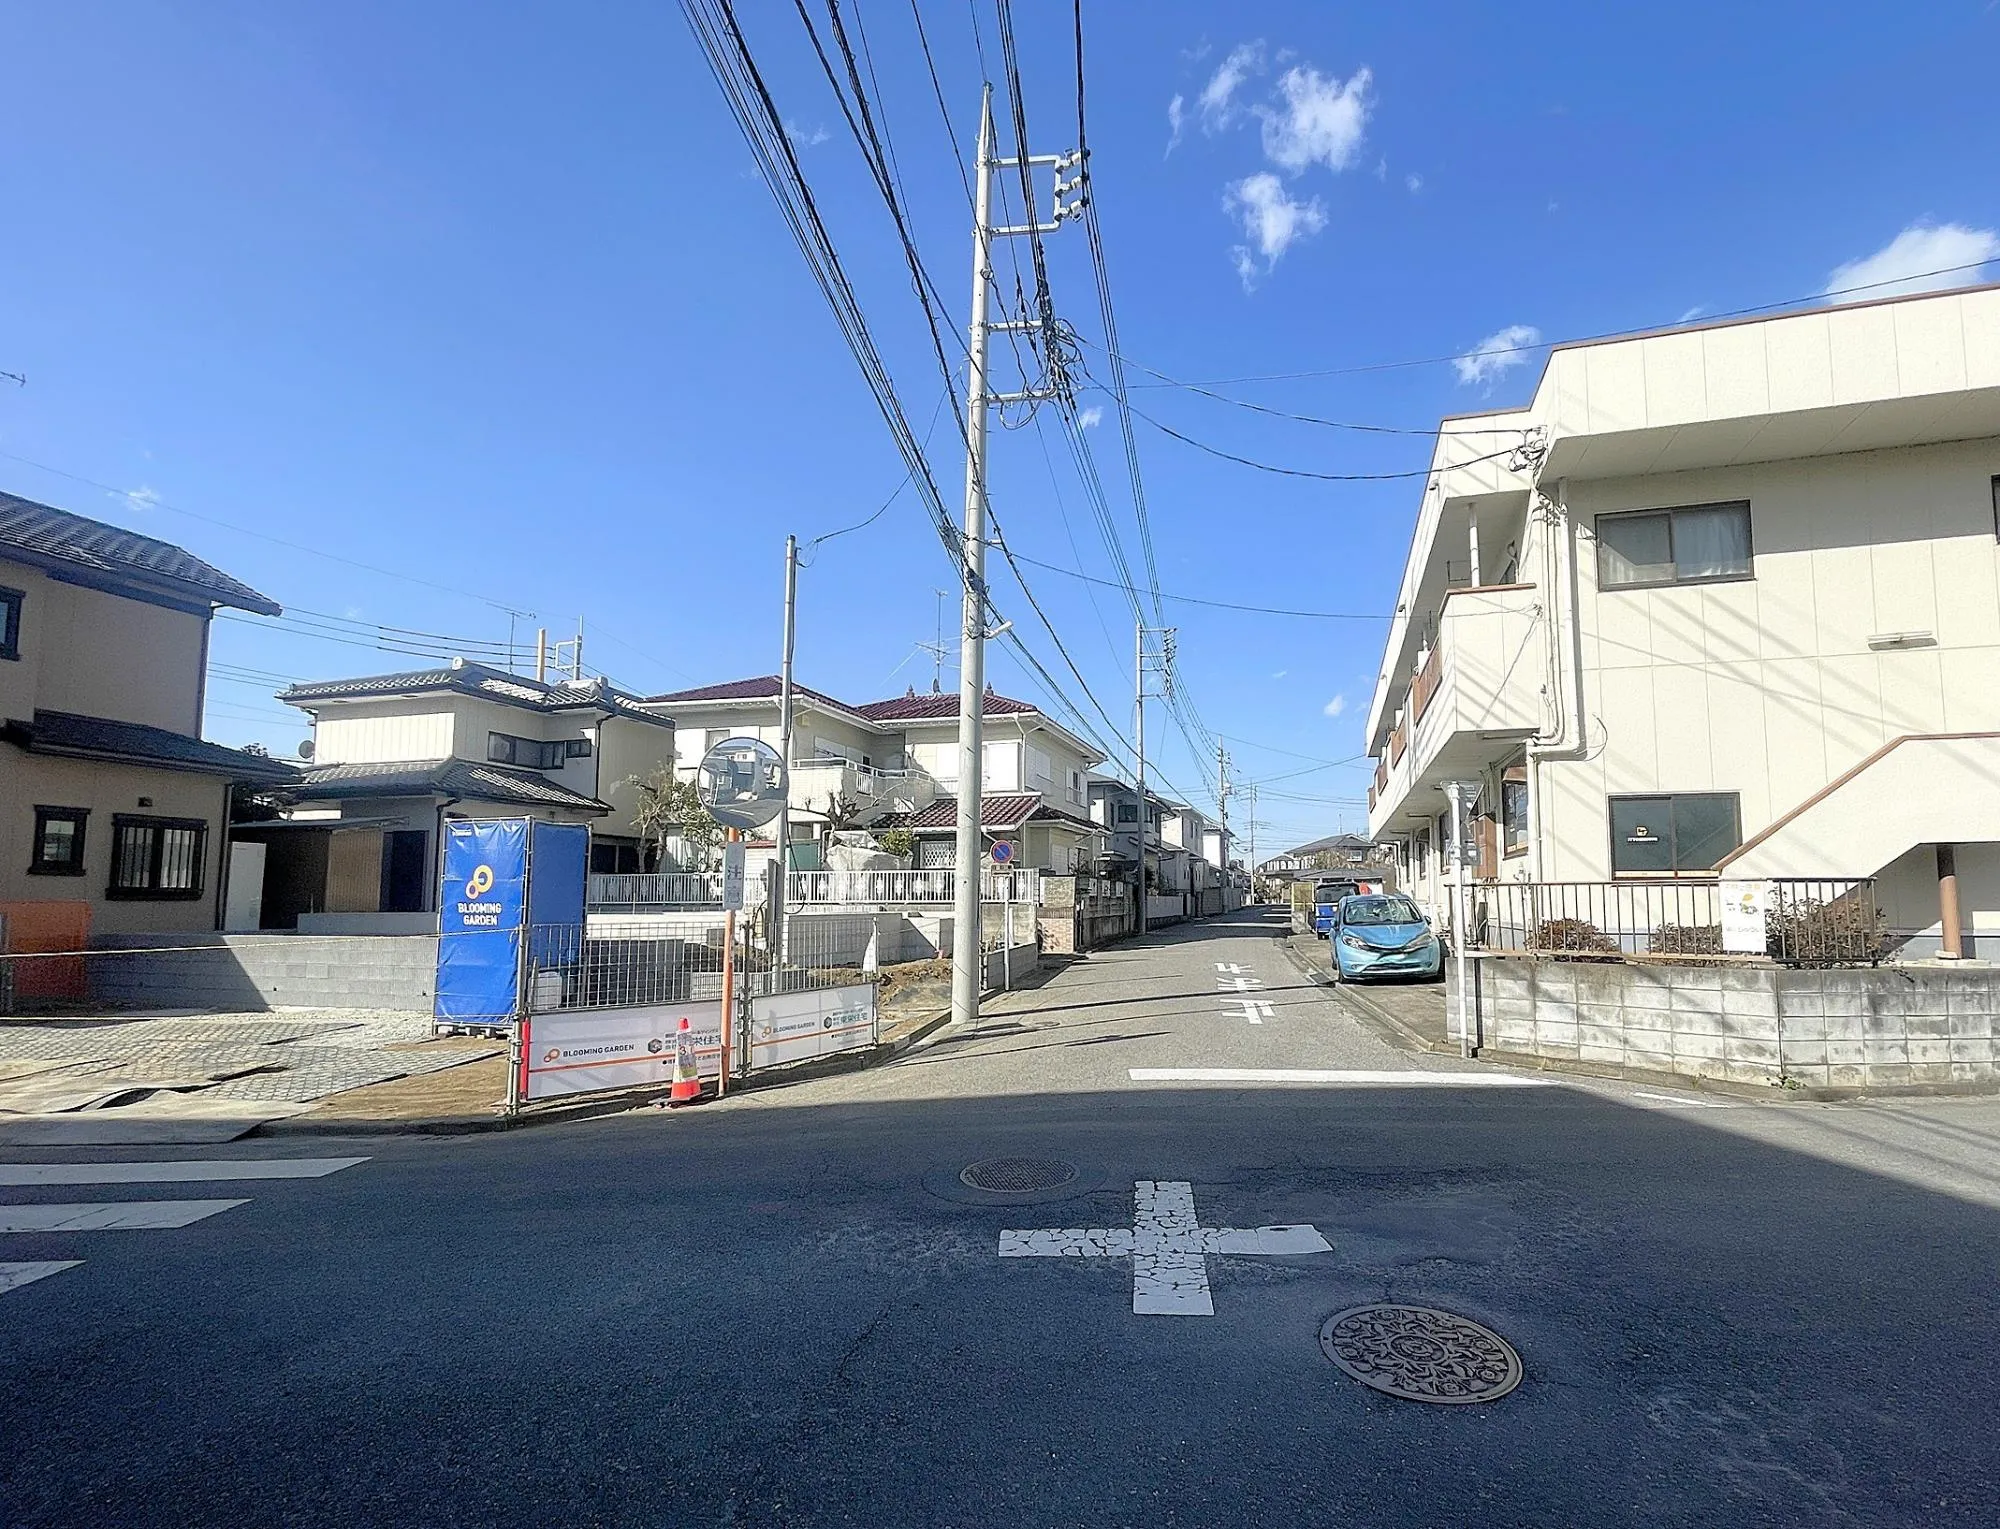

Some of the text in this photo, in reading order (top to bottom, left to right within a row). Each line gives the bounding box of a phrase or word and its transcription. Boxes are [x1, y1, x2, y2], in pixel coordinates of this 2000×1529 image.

[458, 902, 502, 914] BLOOMING
[464, 915, 498, 925] GARDEN
[772, 1022, 815, 1034] BLOOMING GARDEN
[562, 1044, 635, 1058] BLOOMING GARDEN
